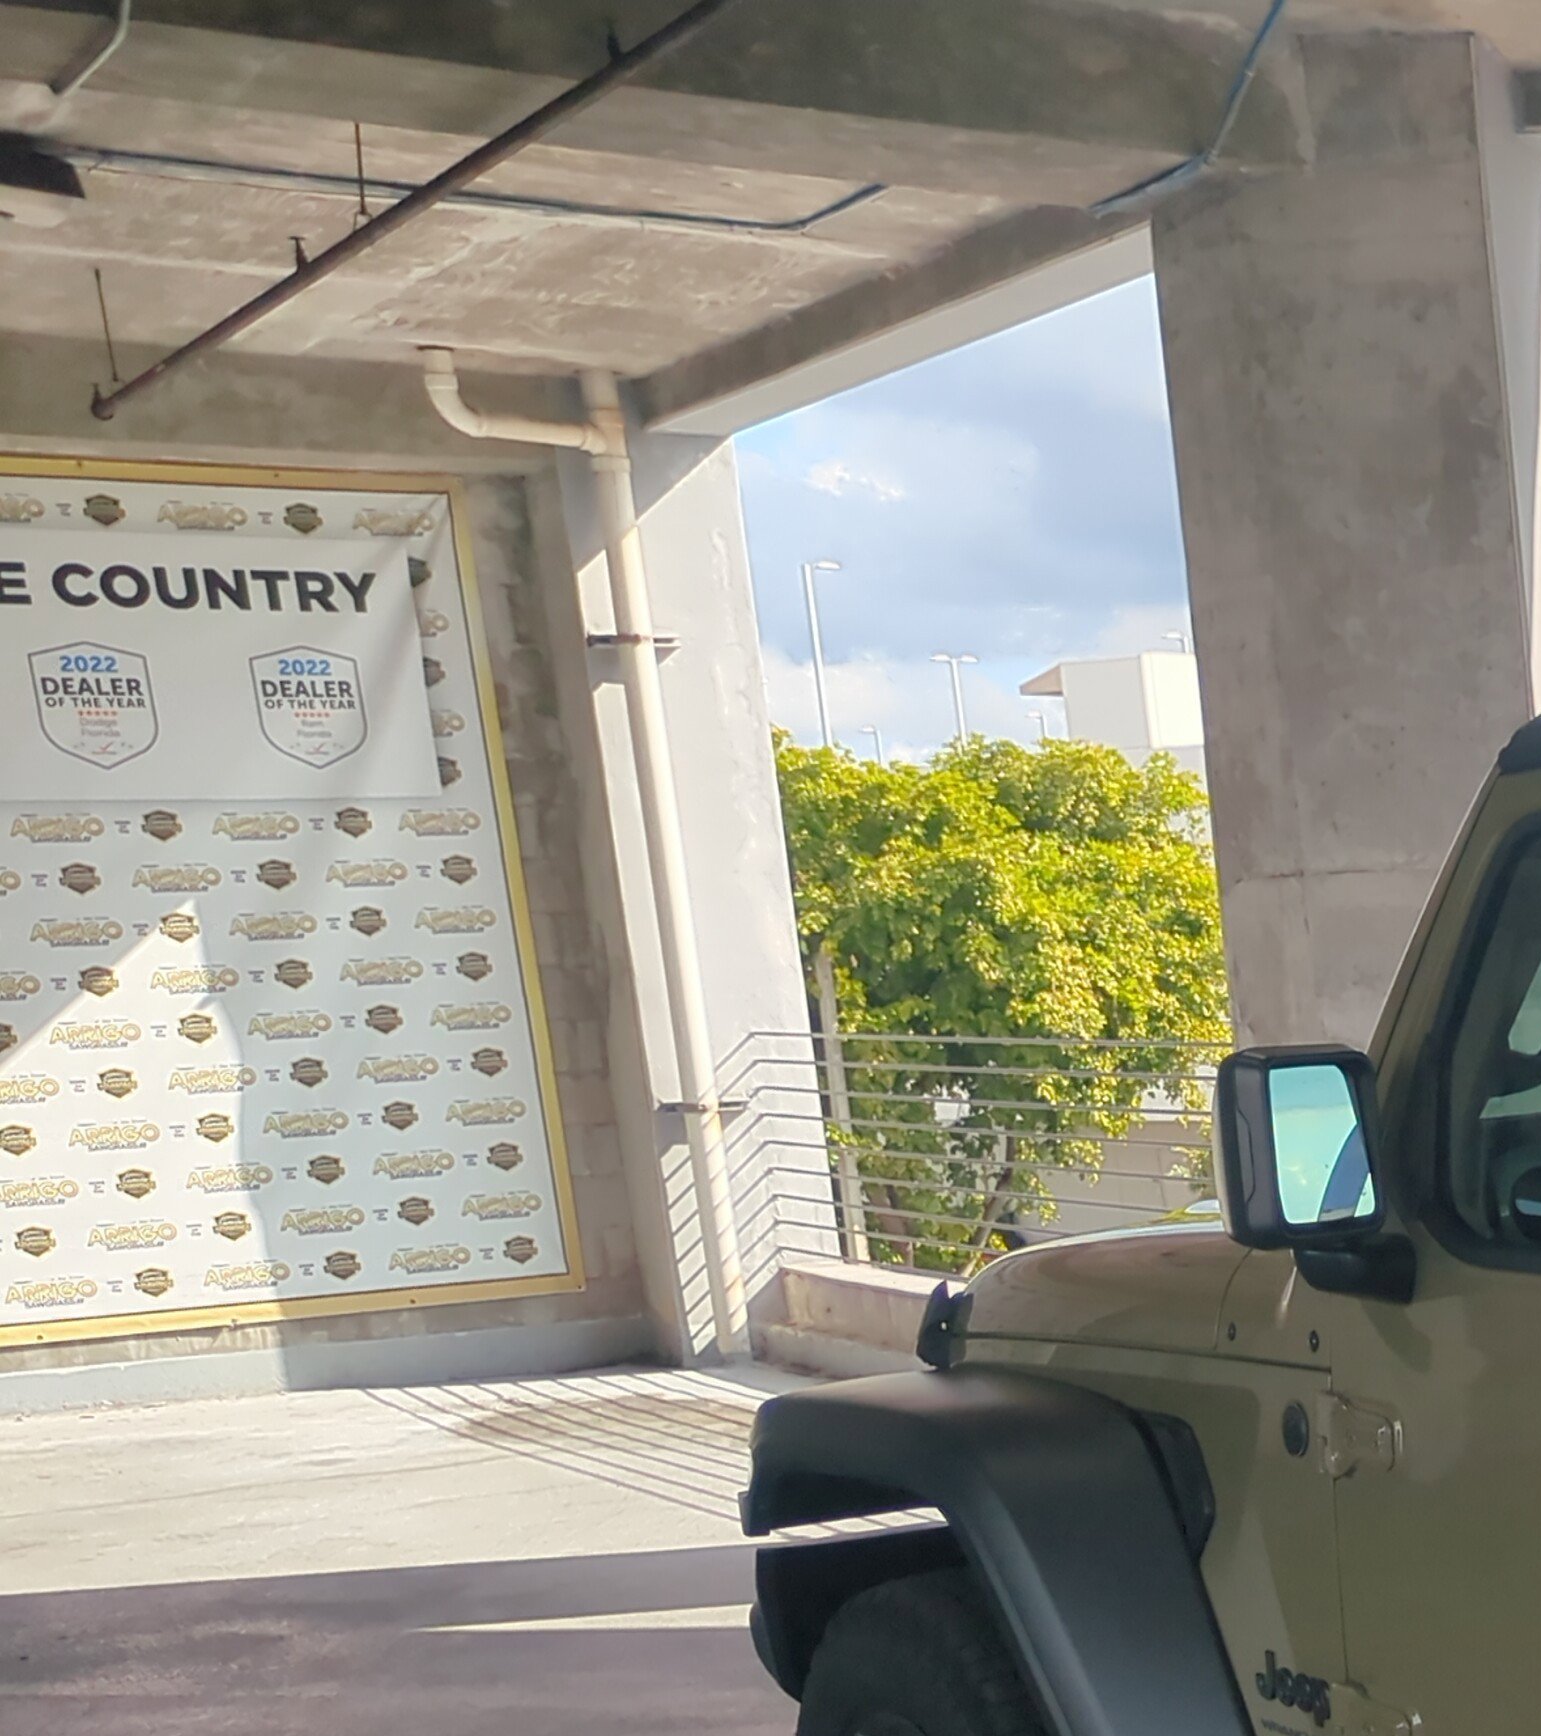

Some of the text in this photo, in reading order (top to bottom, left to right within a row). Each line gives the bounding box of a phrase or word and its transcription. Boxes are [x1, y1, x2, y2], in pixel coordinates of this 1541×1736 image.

[51, 563, 377, 613] COUNTRY
[60, 655, 118, 673] 2022
[278, 659, 332, 676] 2022
[40, 676, 144, 697] DEALER
[260, 679, 354, 699] DEALER
[45, 697, 146, 709] OF THE YEAR
[264, 699, 356, 710] OF THE YEAR
[0, 1078, 59, 1099] RIGO
[0, 1180, 79, 1201] RRIGO
[1256, 1650, 1331, 1728] Jeep
